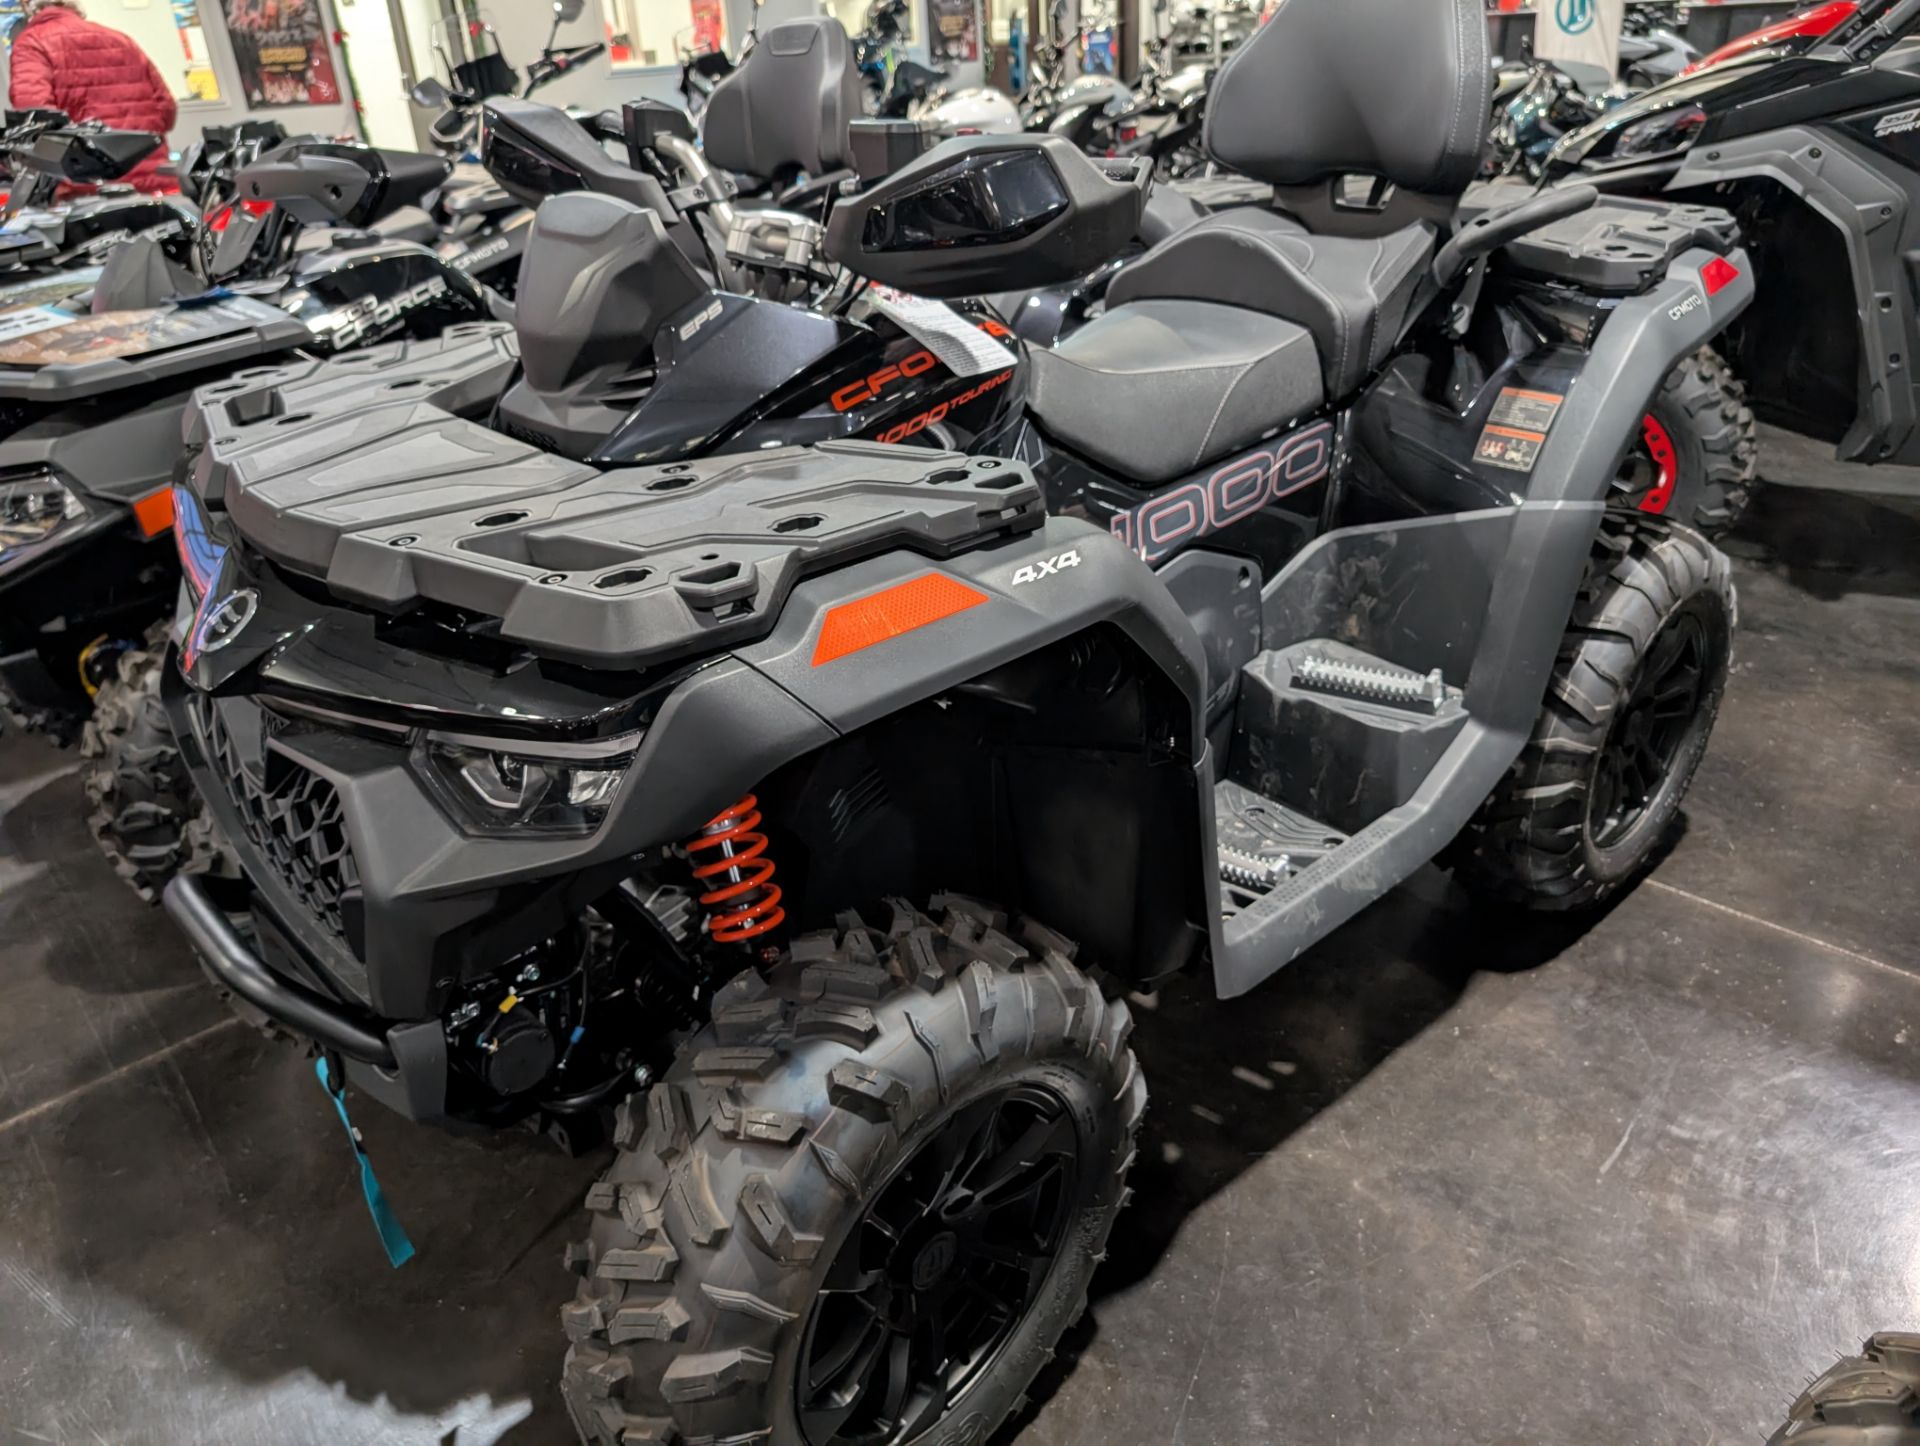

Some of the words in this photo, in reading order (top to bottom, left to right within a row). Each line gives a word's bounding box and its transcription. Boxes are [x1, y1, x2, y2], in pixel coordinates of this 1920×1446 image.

[332, 275, 447, 350] CFORCE
[680, 299, 723, 341] EPS
[1668, 294, 1701, 321] CFMOTO
[950, 368, 1013, 409] TOURING
